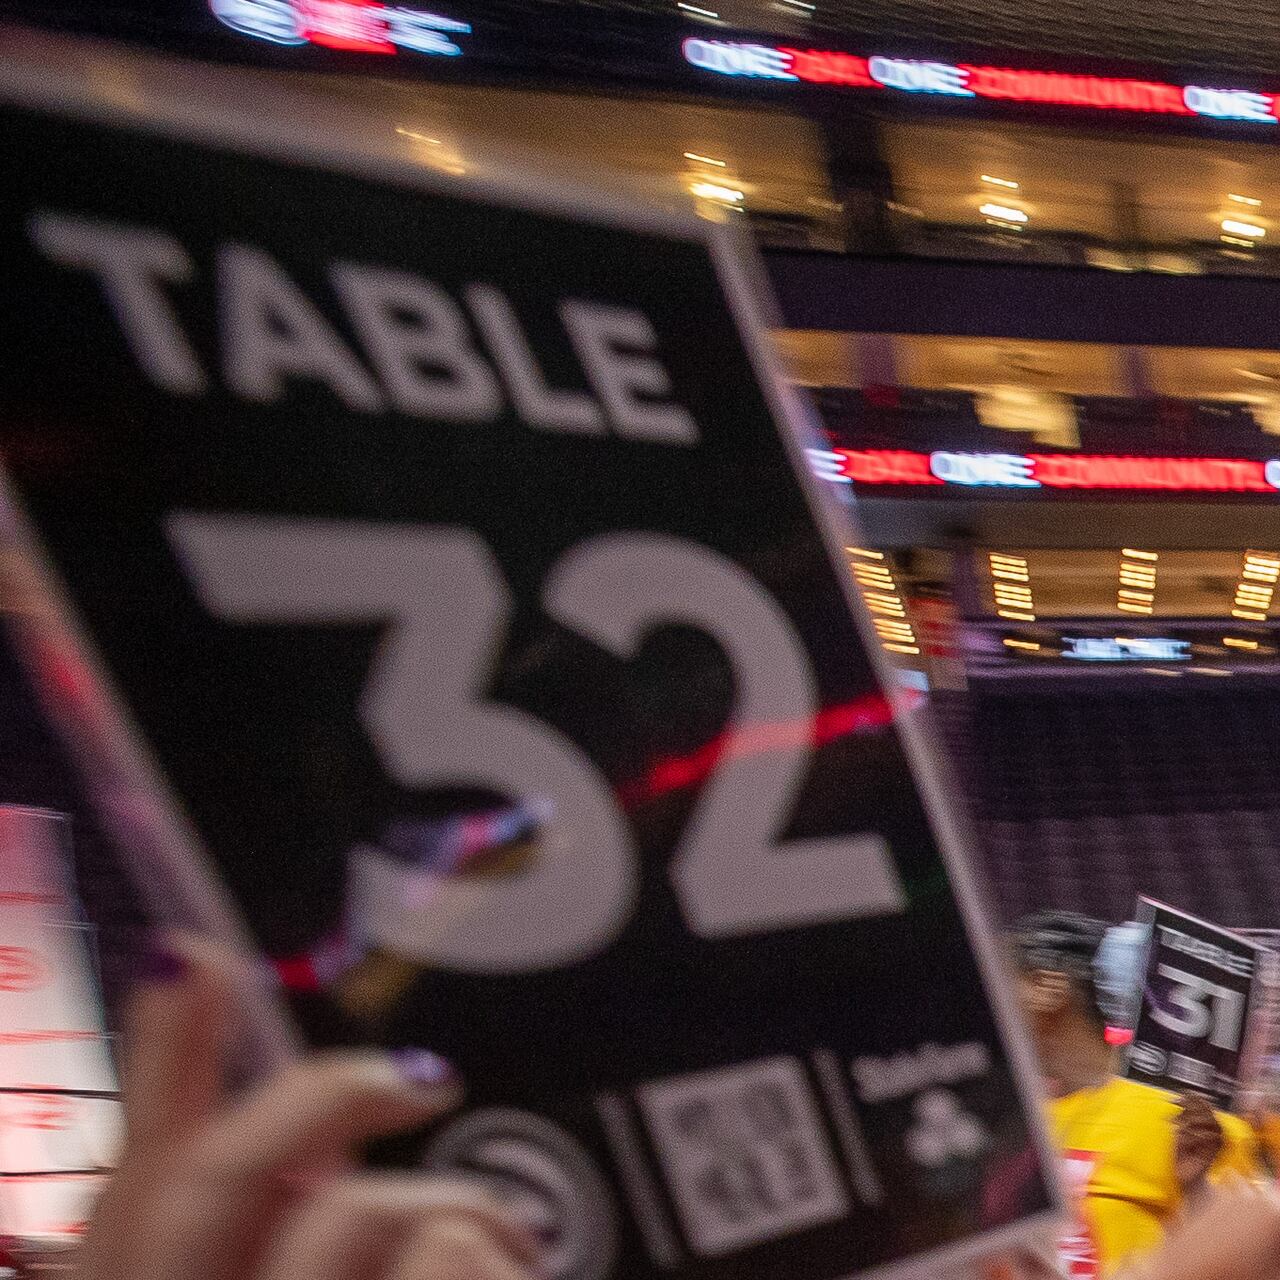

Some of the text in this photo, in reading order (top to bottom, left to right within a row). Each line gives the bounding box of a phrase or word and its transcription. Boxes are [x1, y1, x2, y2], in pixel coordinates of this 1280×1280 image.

[32, 211, 702, 447] TABLE
[165, 510, 910, 973] 32
[1148, 962, 1246, 1051] 31
